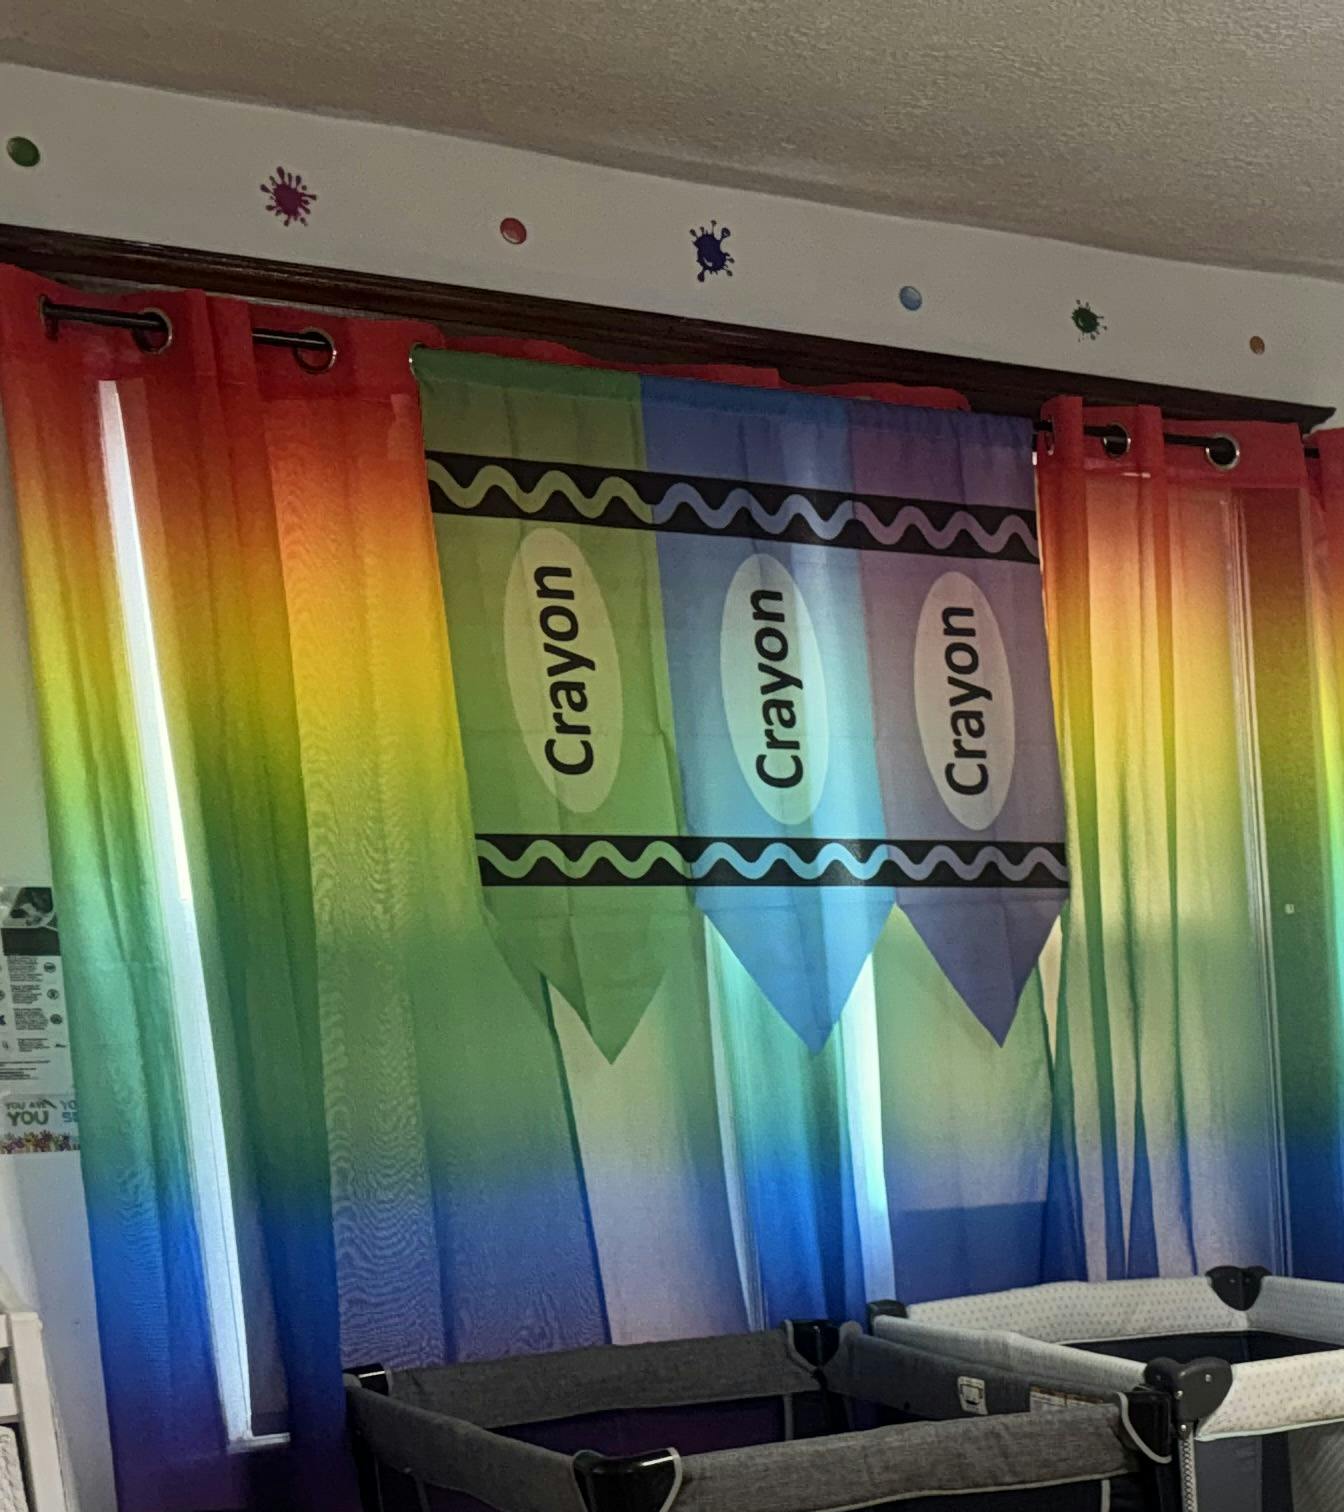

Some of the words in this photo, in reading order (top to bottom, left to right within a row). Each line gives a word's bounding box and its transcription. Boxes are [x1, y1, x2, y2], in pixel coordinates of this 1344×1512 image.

[545, 565, 595, 776] Crayon
[755, 589, 804, 789] Crayon
[939, 605, 993, 796] Crayon
